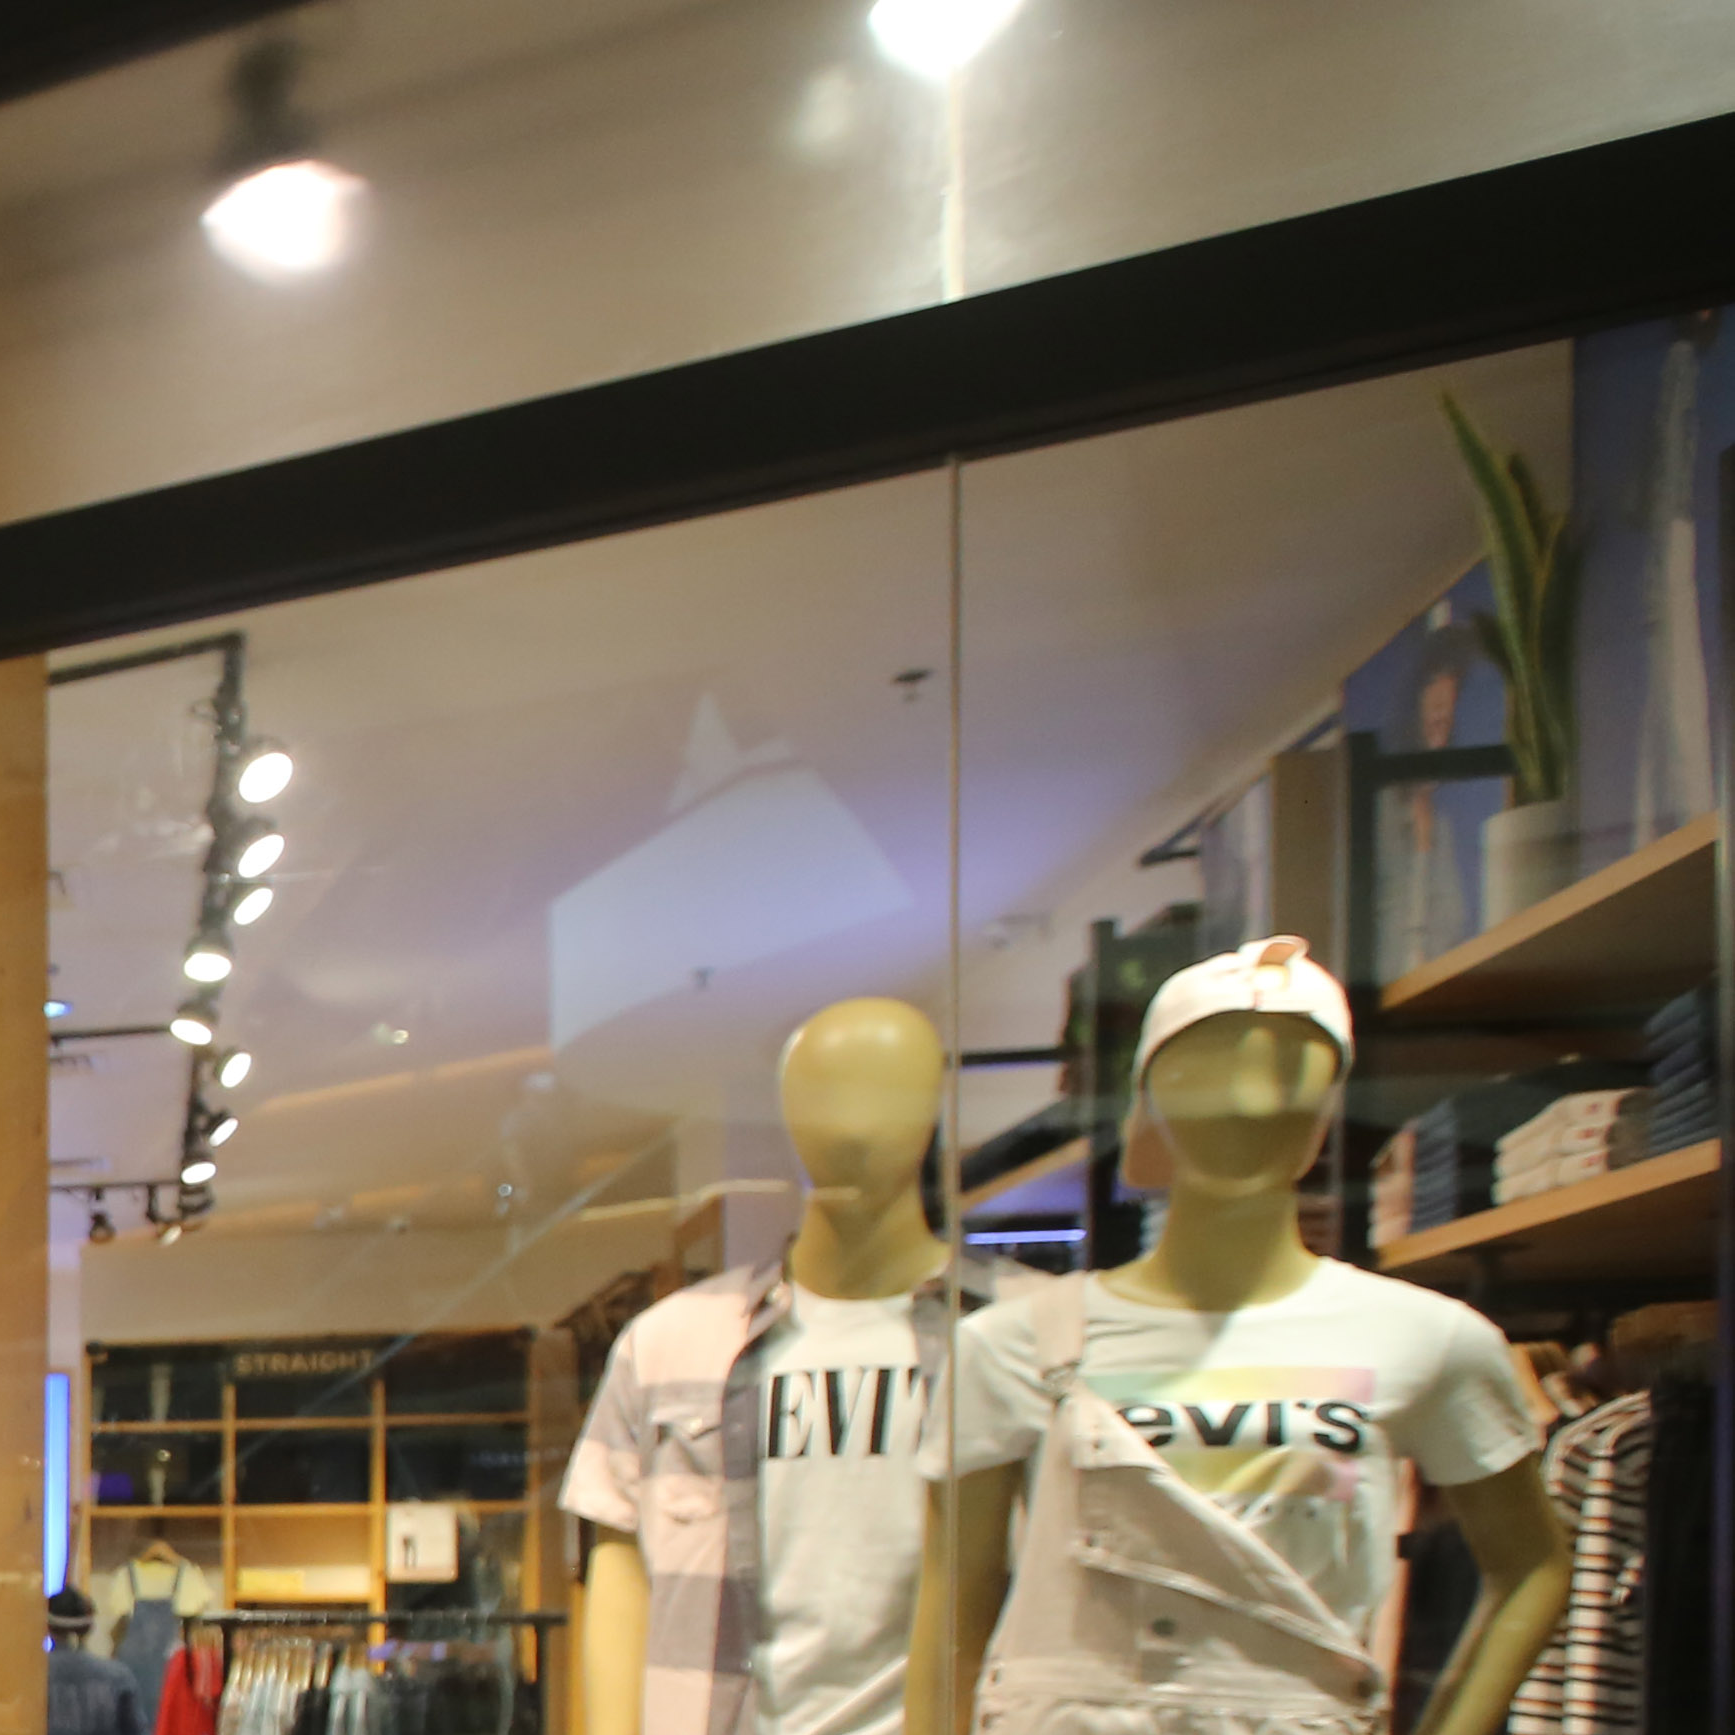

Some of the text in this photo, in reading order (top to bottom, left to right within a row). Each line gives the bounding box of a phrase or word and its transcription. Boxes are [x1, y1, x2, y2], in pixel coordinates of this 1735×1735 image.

[234, 1349, 375, 1375] STRAIGHT
[767, 1367, 932, 1459] EVI'
[1118, 1402, 1367, 1452] evi's
